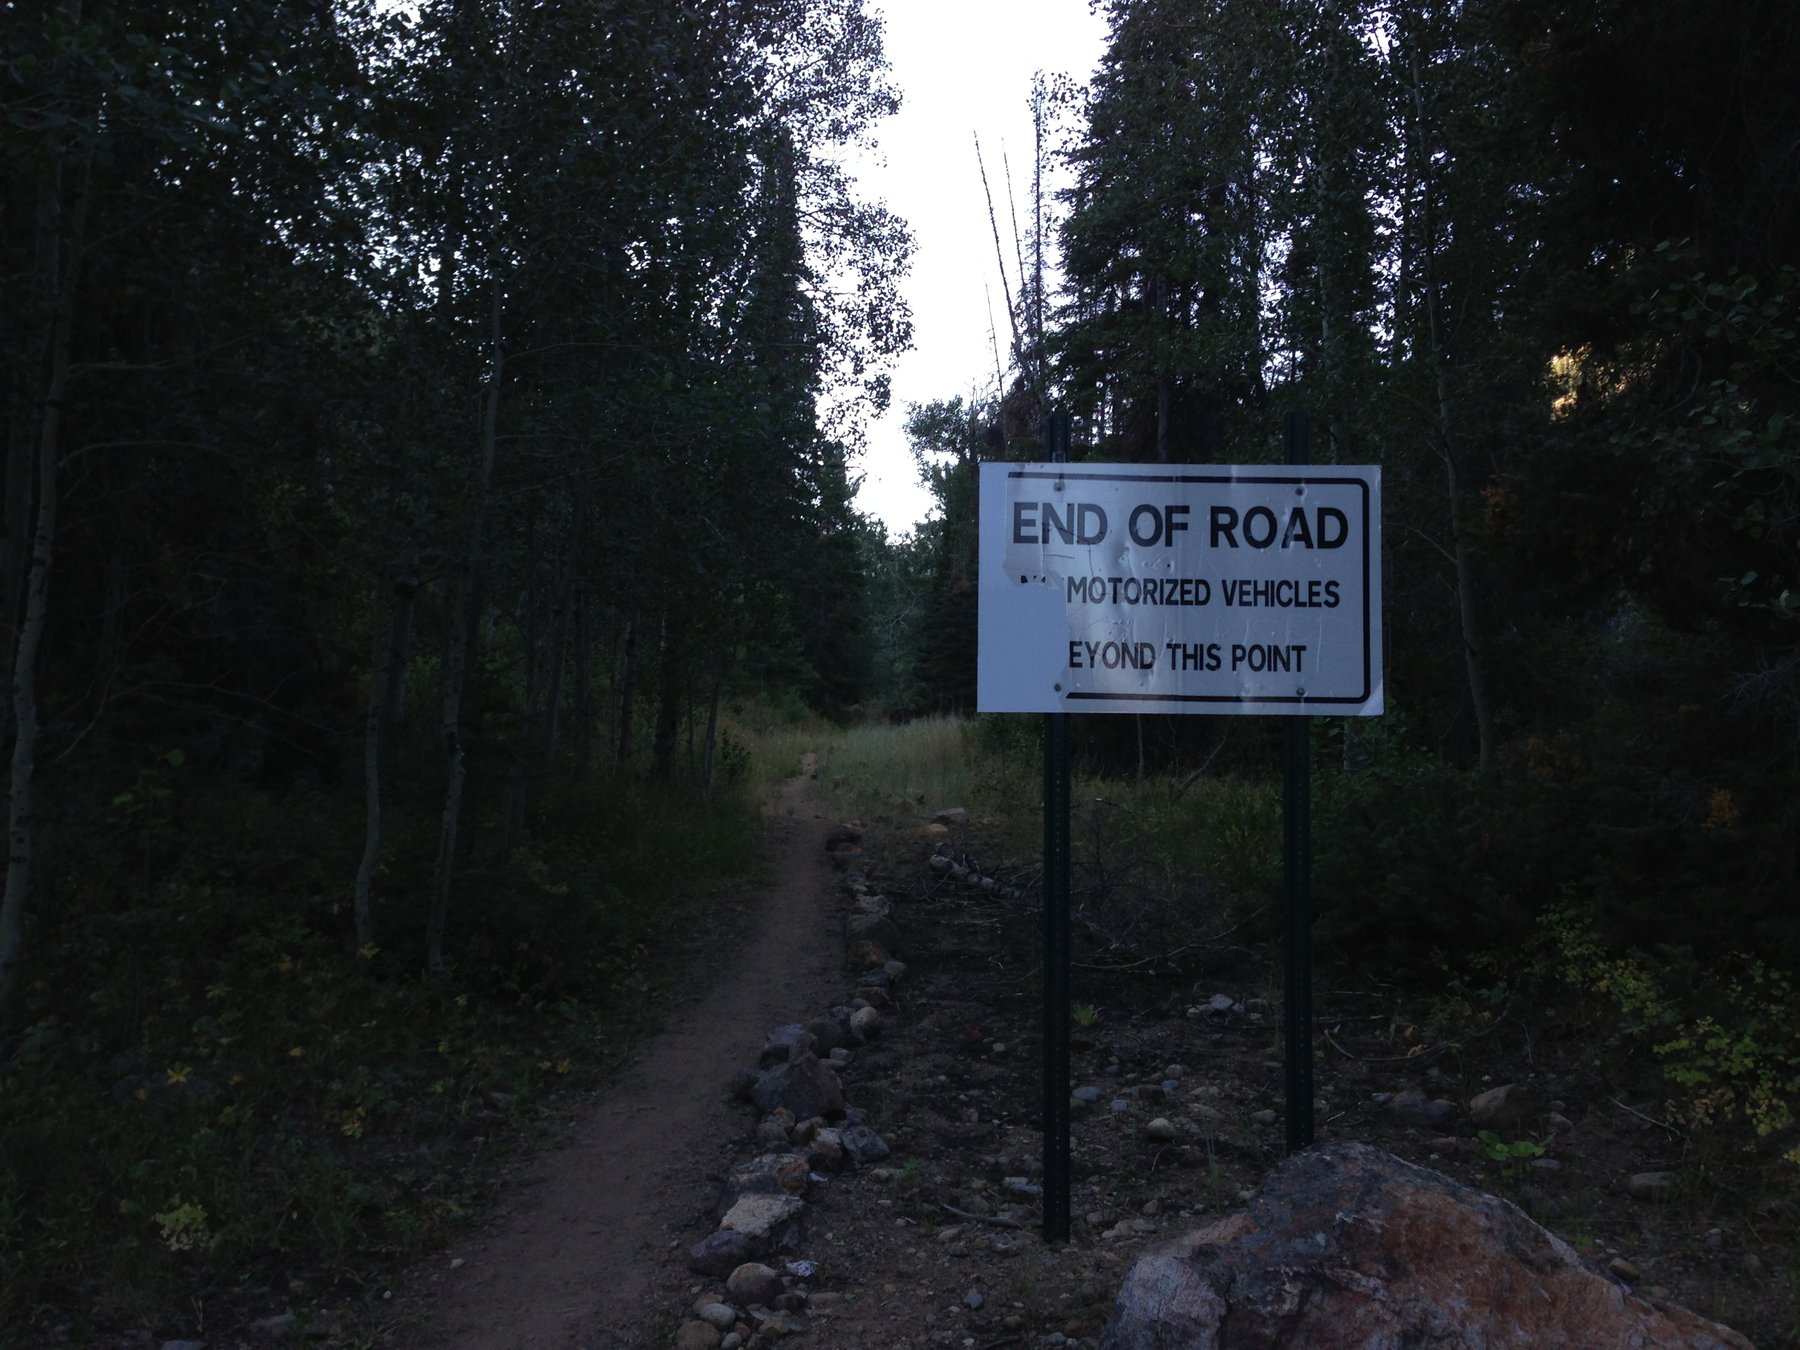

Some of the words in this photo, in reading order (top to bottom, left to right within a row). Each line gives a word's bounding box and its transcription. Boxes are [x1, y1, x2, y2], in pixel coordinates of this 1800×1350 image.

[1013, 502, 1108, 545] END
[1128, 503, 1190, 548] OF
[1210, 505, 1349, 549] ROAD
[1067, 575, 1211, 606] MOTORIZED
[1222, 578, 1340, 608] VEHICLES
[1069, 641, 1156, 670] EYOND
[1166, 643, 1222, 671] THIS
[1232, 644, 1307, 672] POINT
